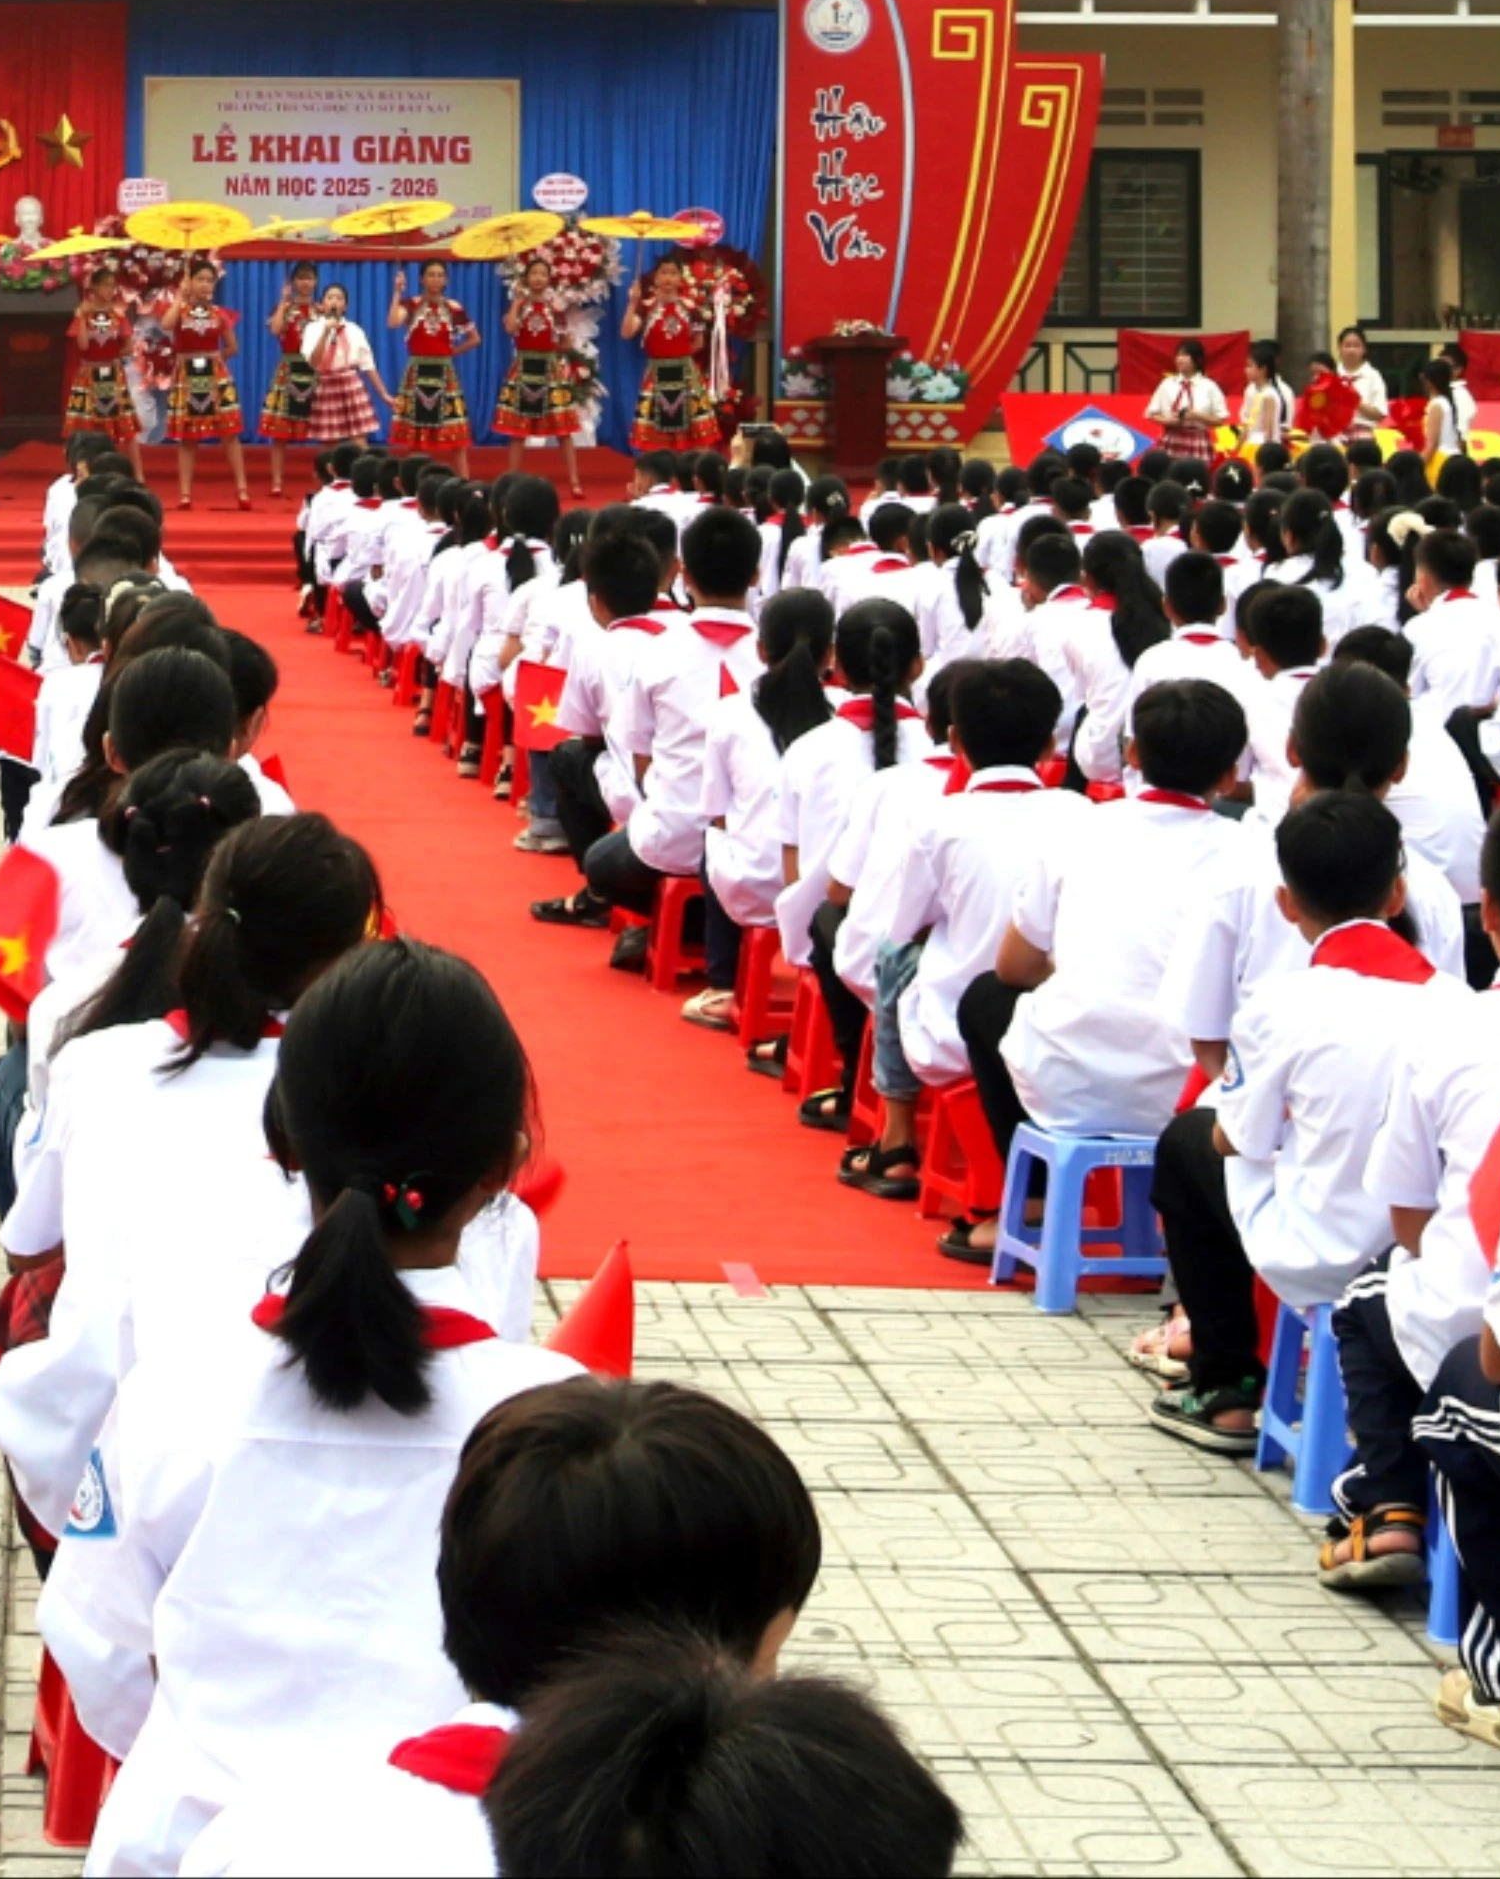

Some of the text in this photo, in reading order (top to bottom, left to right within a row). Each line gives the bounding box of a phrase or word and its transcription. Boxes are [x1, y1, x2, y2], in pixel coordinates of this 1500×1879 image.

[192, 122, 472, 165] LỄ KHAI GIẢNG
[225, 174, 272, 196] NĂM
[277, 175, 316, 201] HỌC
[324, 176, 371, 197] 2025
[391, 178, 439, 199] 2026
[812, 149, 885, 205] Học
[807, 212, 886, 264] Văn
